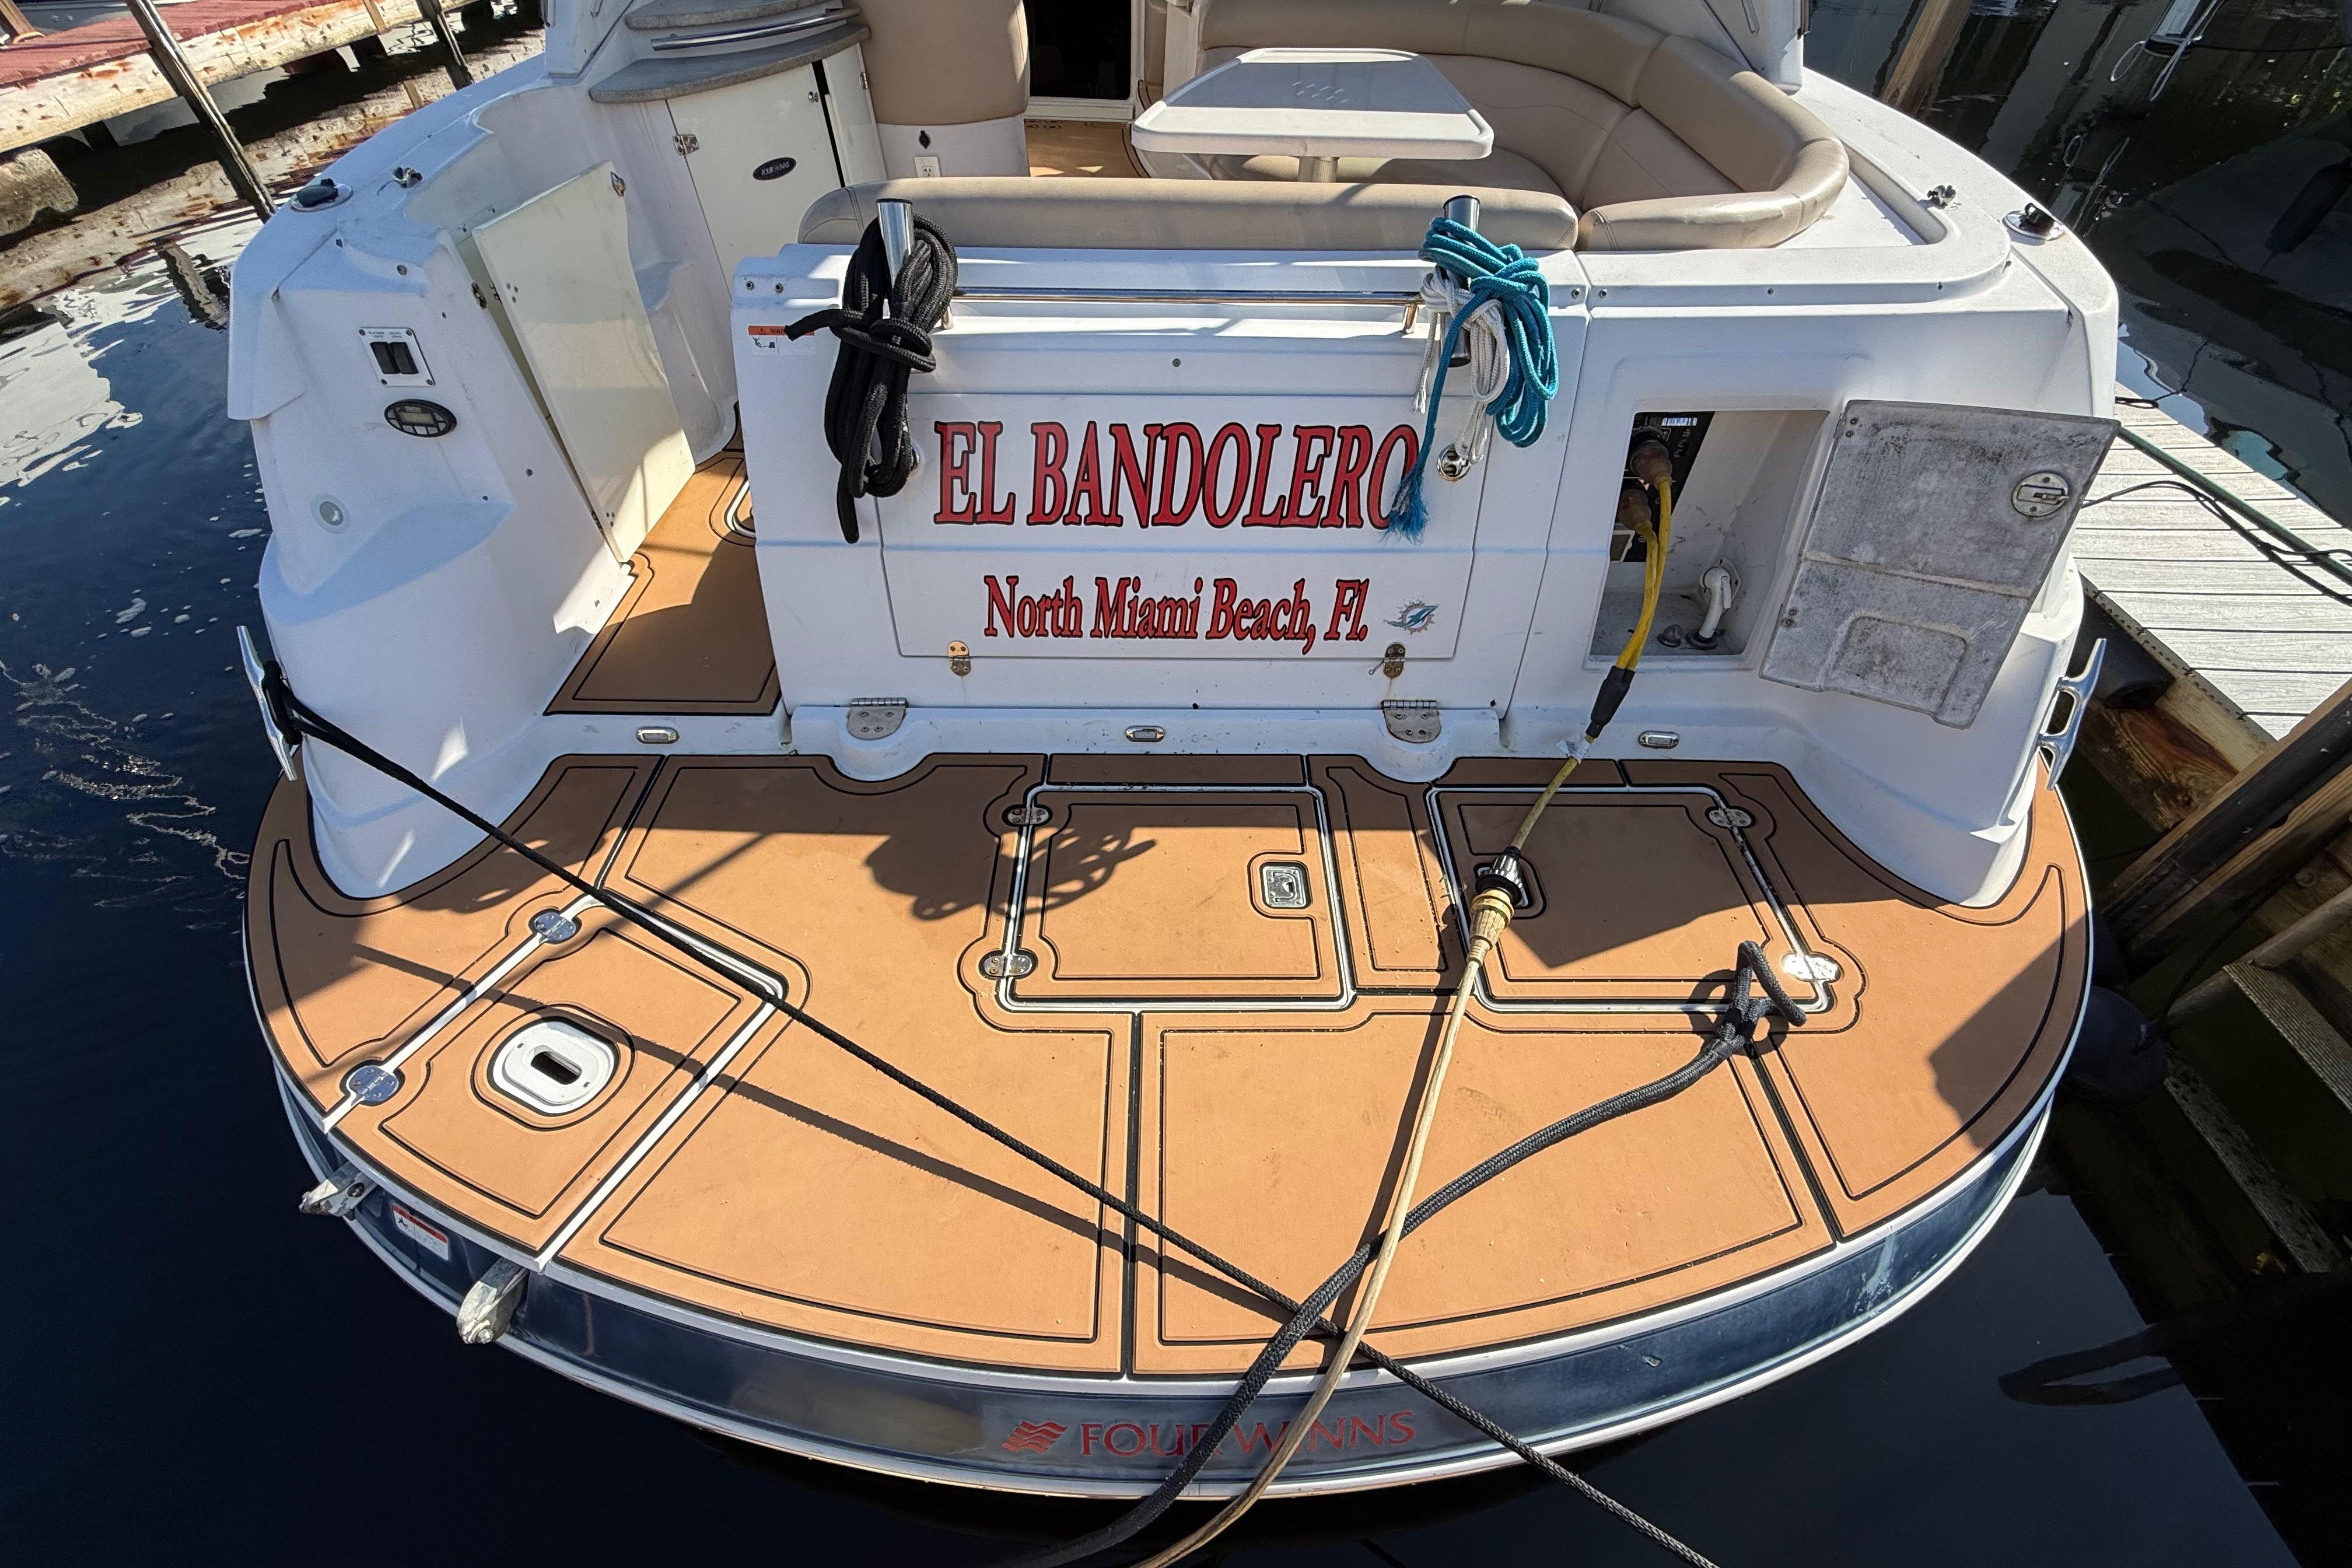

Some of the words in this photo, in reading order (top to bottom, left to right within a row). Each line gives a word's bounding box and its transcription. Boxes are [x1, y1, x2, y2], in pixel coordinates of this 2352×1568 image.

[934, 421, 1015, 525] EL
[1026, 421, 1420, 529] BANDOLERO
[984, 575, 1083, 639] North
[1091, 576, 1203, 640] Miami
[1206, 578, 1317, 655] Beach,
[1232, 1410, 1415, 1455] WNNS
